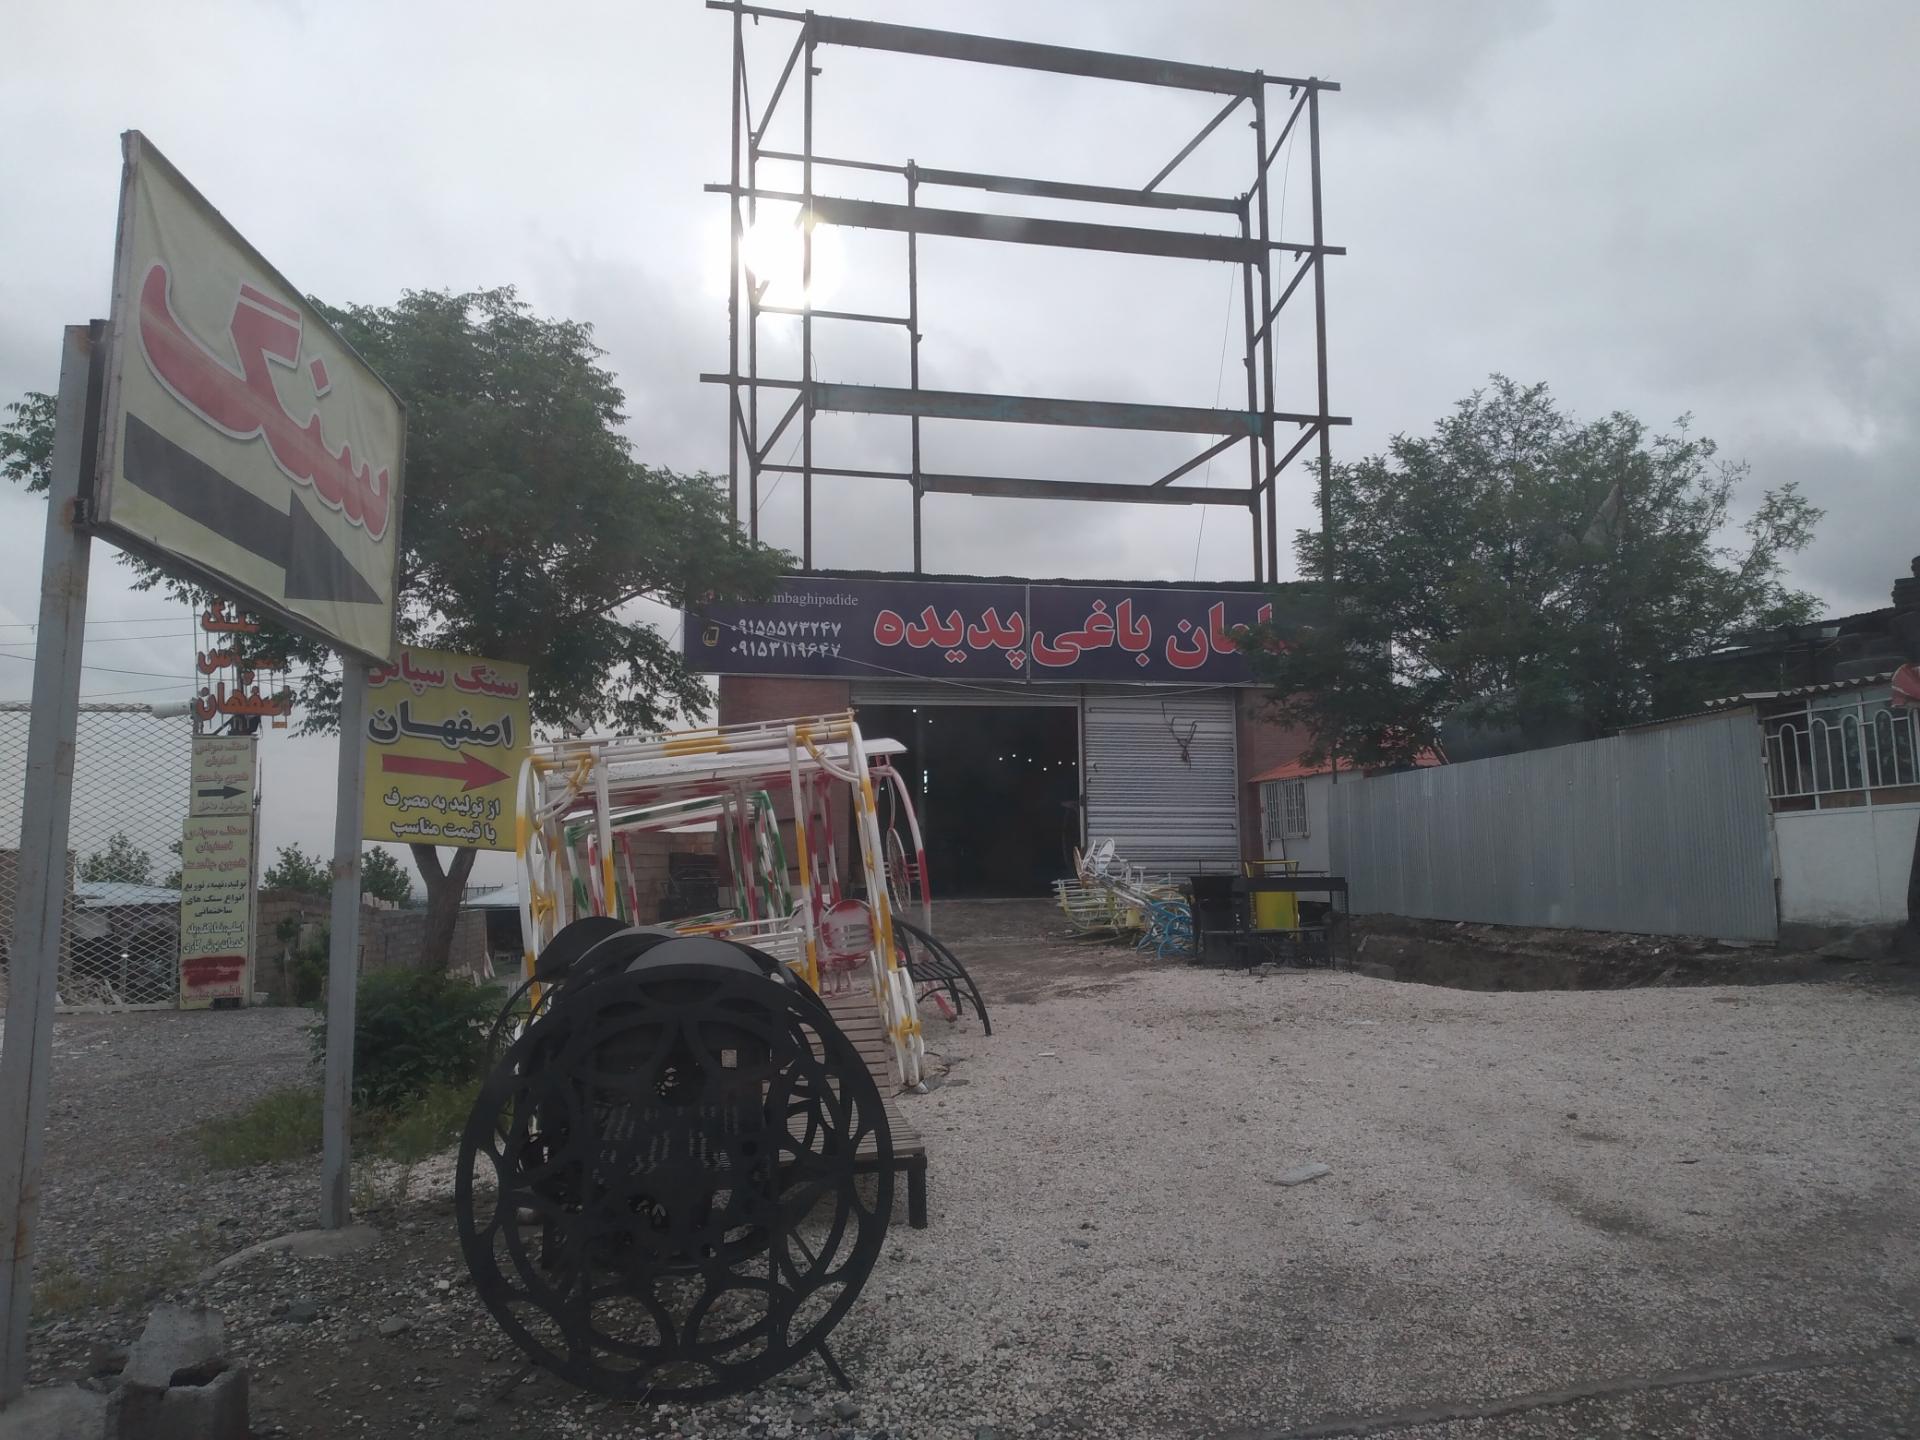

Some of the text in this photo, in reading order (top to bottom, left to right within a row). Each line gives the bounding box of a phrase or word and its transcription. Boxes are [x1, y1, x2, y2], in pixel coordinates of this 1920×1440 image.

[138, 261, 390, 543] سنگ
[874, 605, 1027, 670] پدیده
[1031, 597, 1152, 667] باغی
[453, 664, 521, 699] سنگ
[367, 700, 515, 750] اصفهان
[383, 787, 501, 821] از تولید به مصرف
[390, 817, 497, 845] با قیمت مناسب
